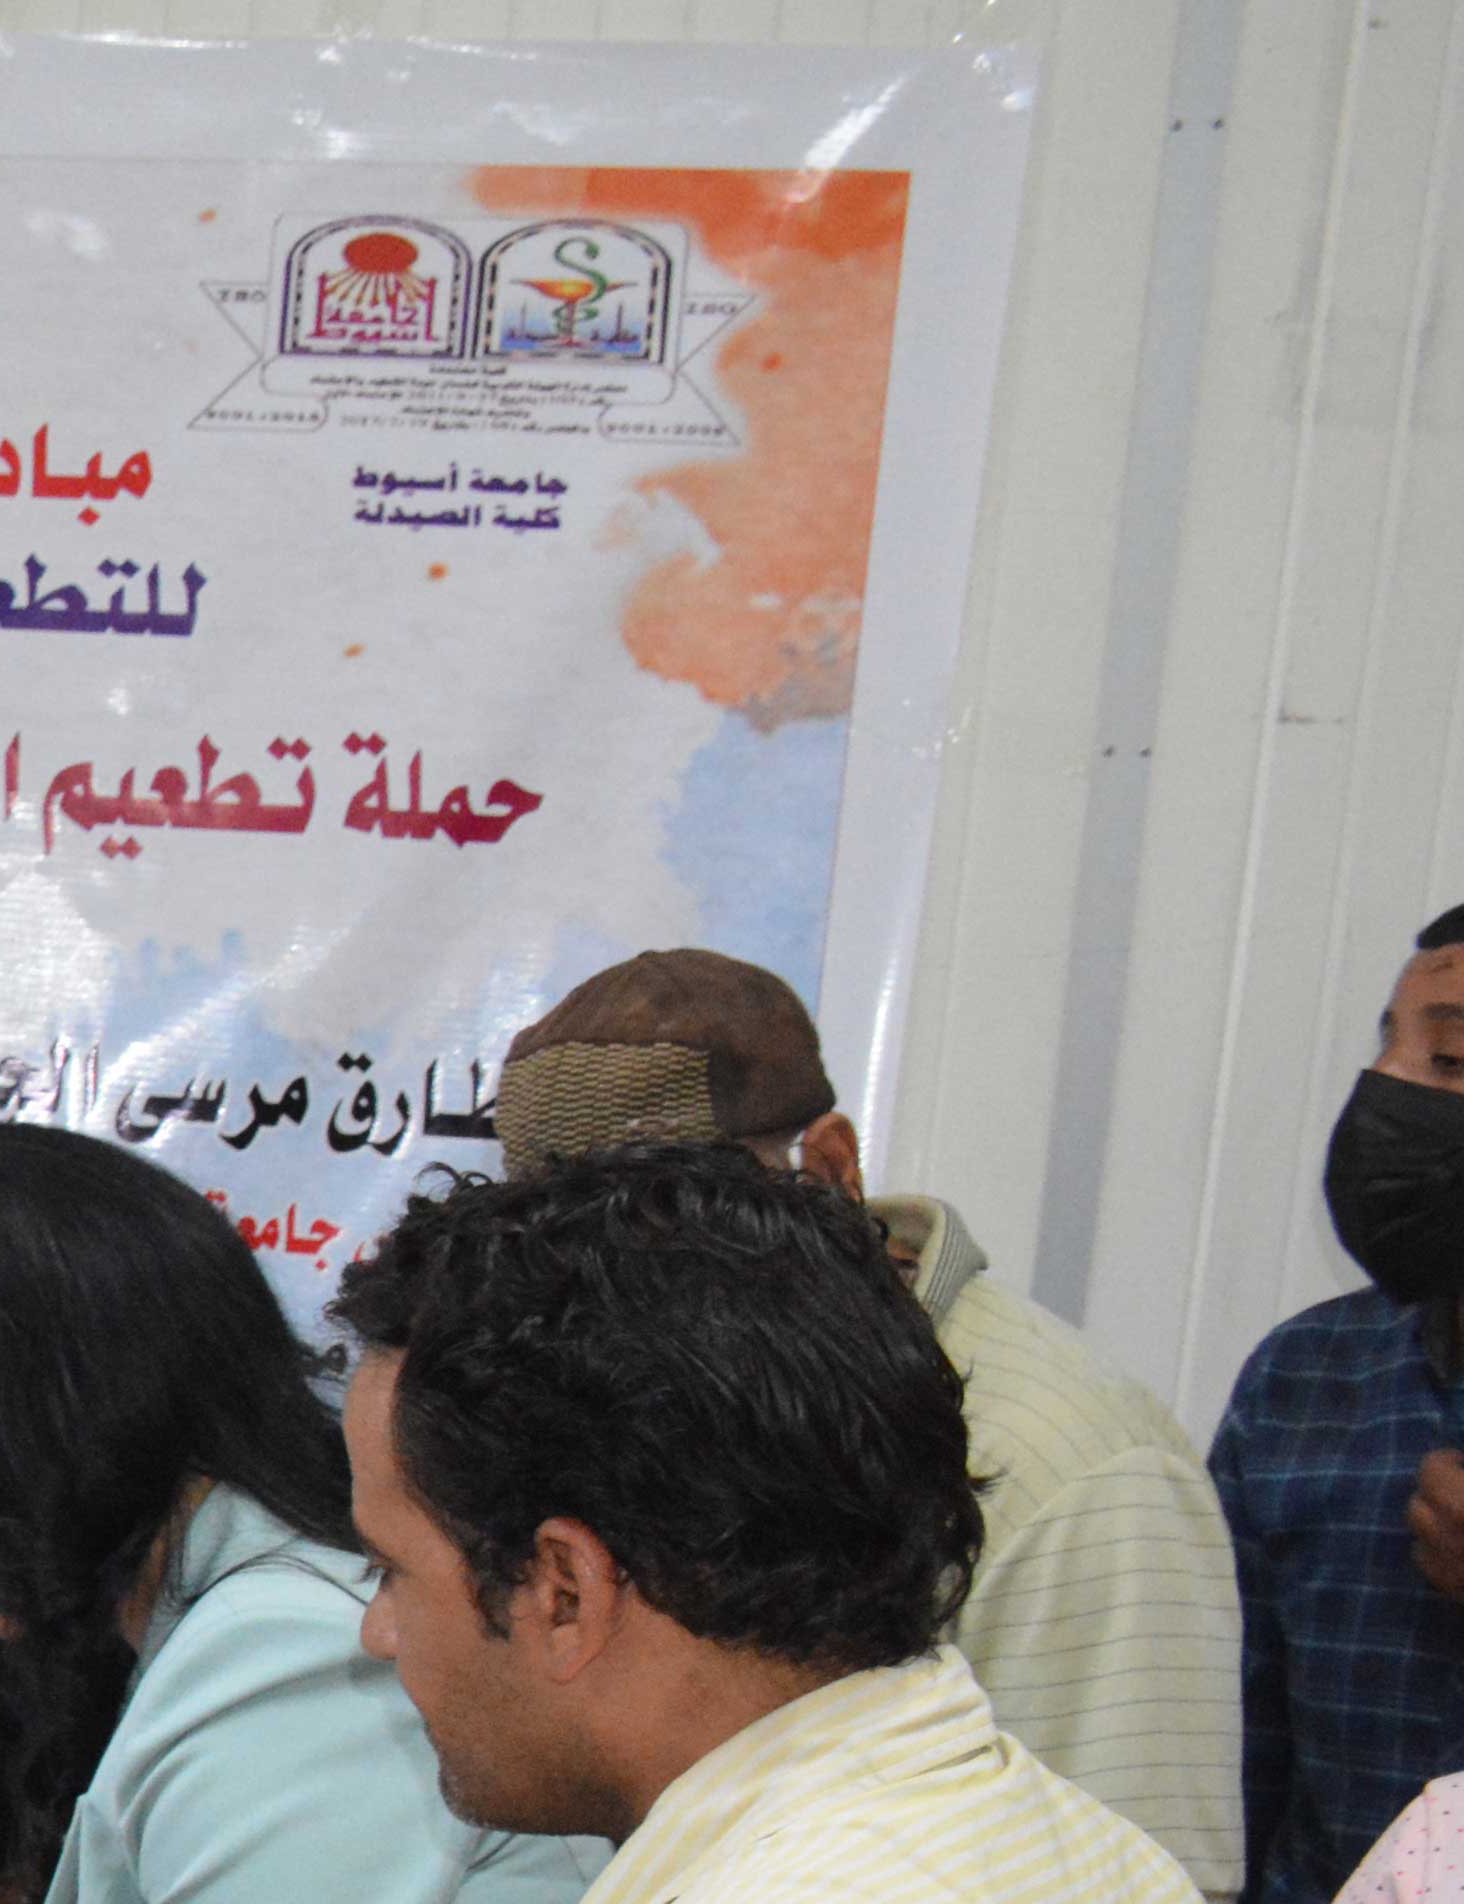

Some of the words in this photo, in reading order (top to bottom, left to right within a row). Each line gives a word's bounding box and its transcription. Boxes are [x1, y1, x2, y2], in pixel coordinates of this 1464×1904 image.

[352, 462, 458, 496] أسيوط
[468, 469, 568, 499] جامعة
[354, 500, 482, 531] الصيدلة
[492, 505, 561, 533] كلية
[42, 735, 316, 860] تطعيم
[342, 732, 544, 849] حملة
[207, 1189, 342, 1270] جامع
